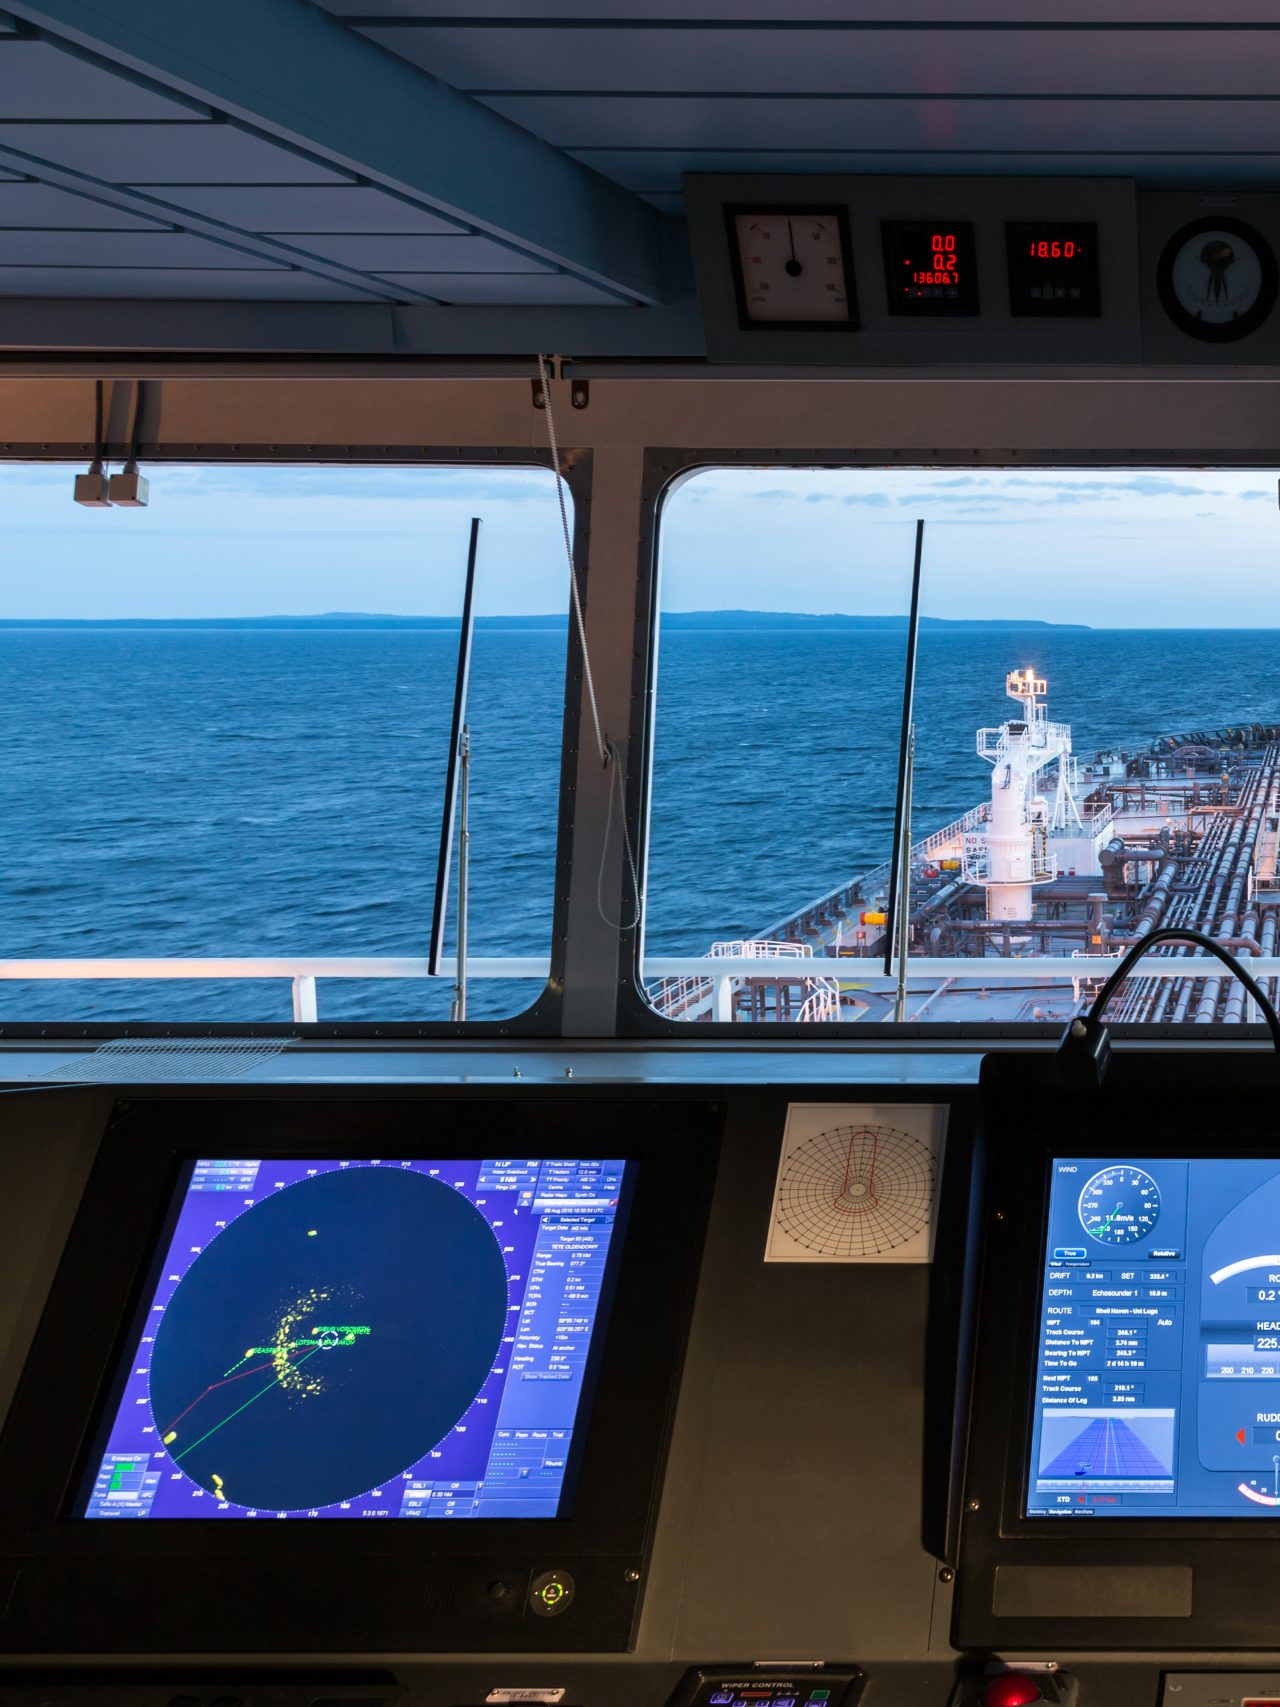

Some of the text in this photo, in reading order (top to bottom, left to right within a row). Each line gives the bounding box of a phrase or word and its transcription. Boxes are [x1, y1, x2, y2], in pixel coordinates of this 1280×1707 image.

[931, 235, 955, 252] 0.0
[1031, 241, 1075, 258] 18.60
[933, 254, 957, 271] 0.2
[1050, 1272, 1070, 1280] DRIFT
[1121, 1272, 1136, 1280] SET
[1258, 1291, 1276, 1301] 0.2
[1048, 1307, 1073, 1315] ROUTE
[1221, 1367, 1234, 1375] 200
[1241, 1367, 1254, 1375] 210
[1261, 1367, 1274, 1375] 220
[1075, 1397, 1088, 1405] Leg
